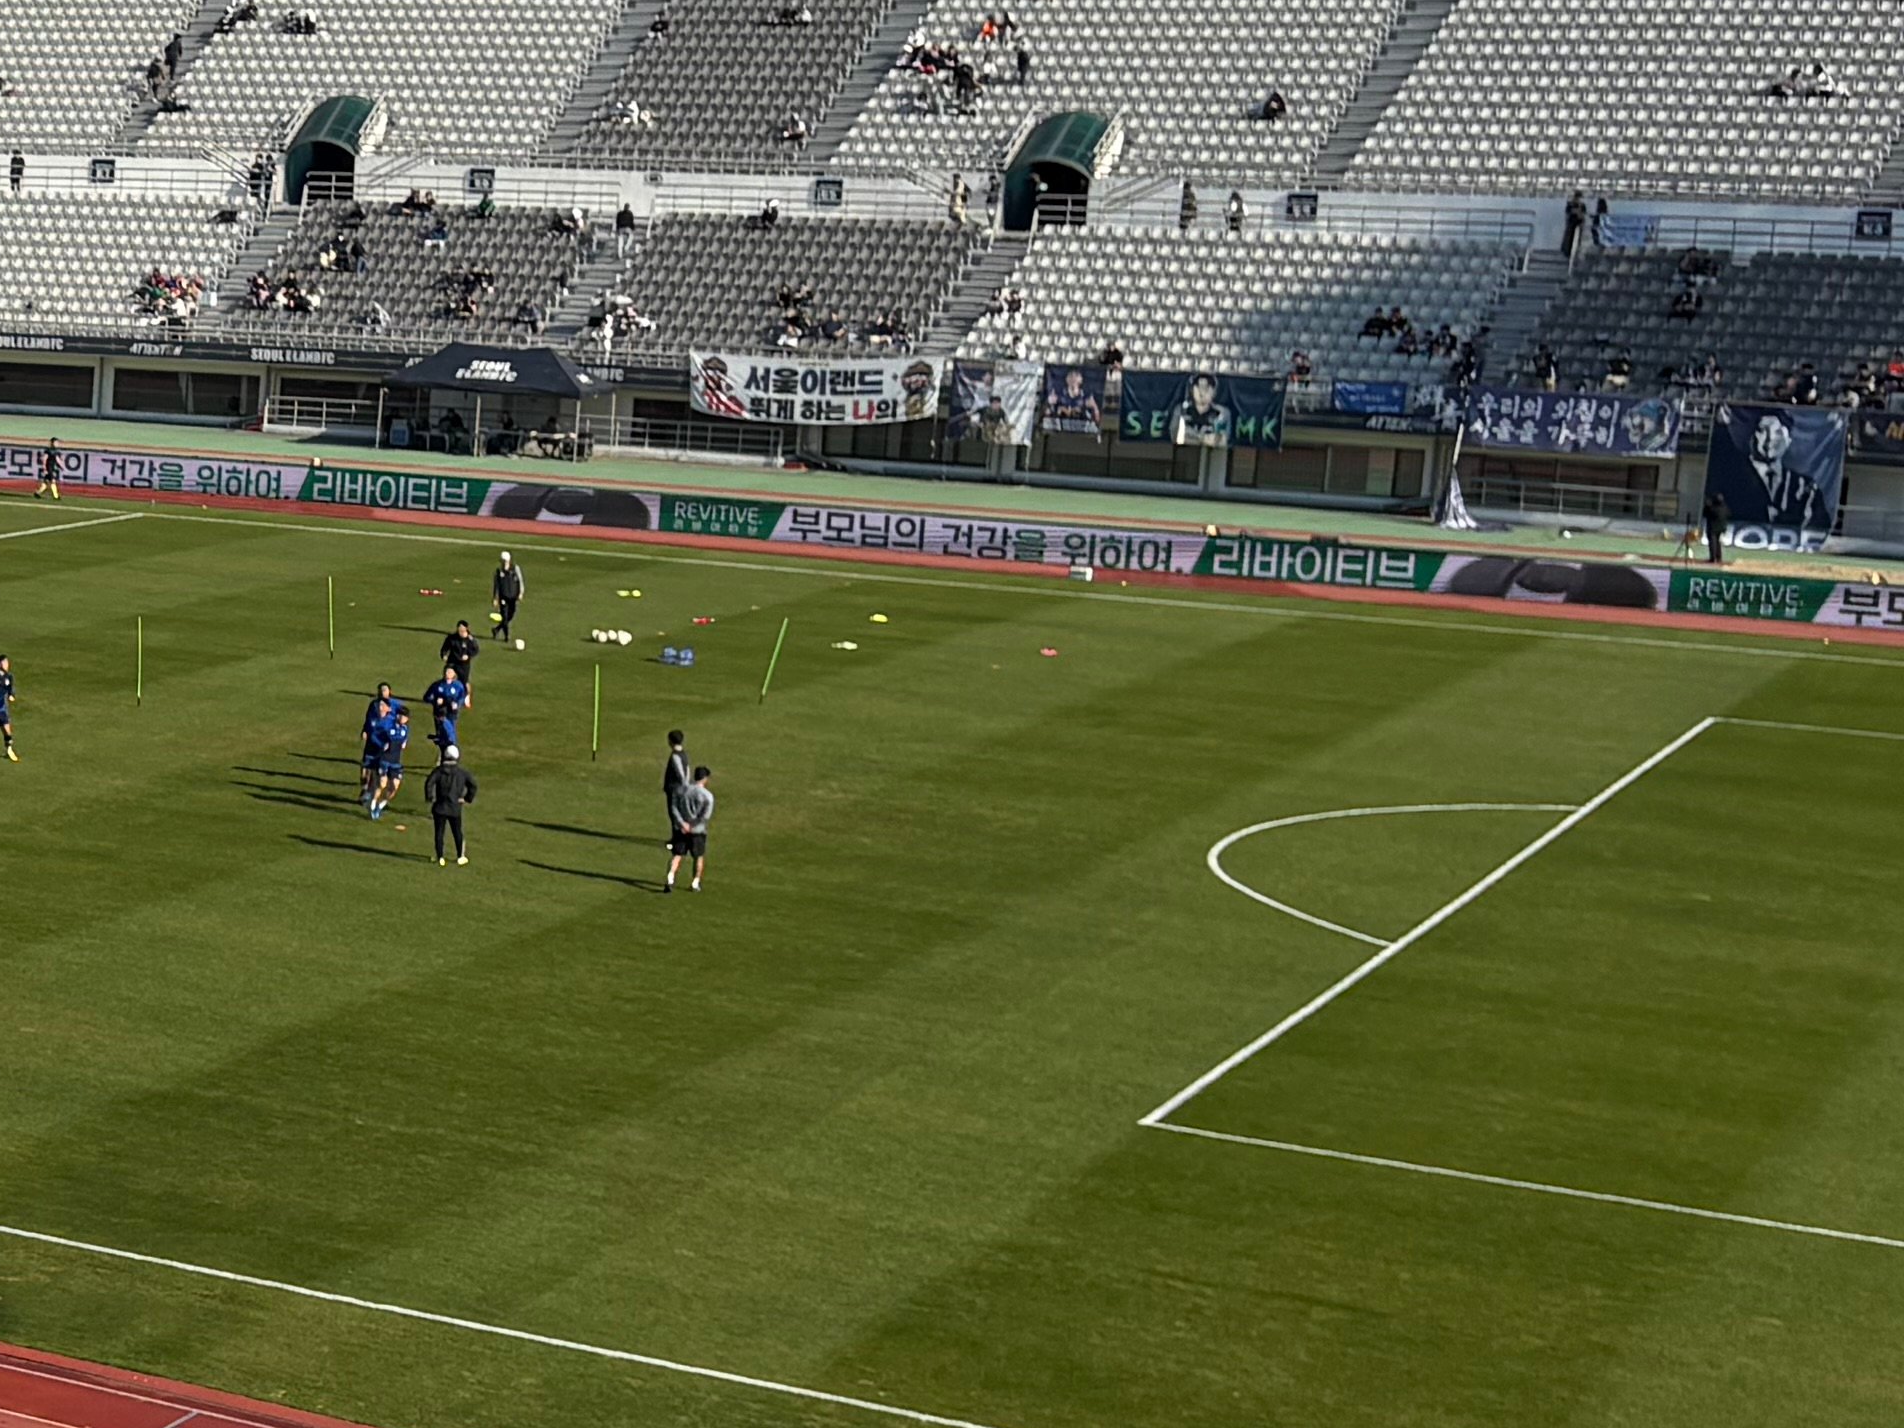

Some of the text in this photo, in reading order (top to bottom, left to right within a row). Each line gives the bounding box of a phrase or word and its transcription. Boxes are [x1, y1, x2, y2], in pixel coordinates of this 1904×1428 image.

[744, 366, 883, 395] 서울이랜드
[101, 458, 186, 490] 건강을
[312, 472, 469, 513] 리바이티브
[674, 501, 763, 524] REVITIVE
[790, 507, 925, 550] 부모님의
[941, 523, 1047, 563] 건강을
[1213, 539, 1416, 588] 리바이티브
[1689, 577, 1803, 607] REVITIVE
